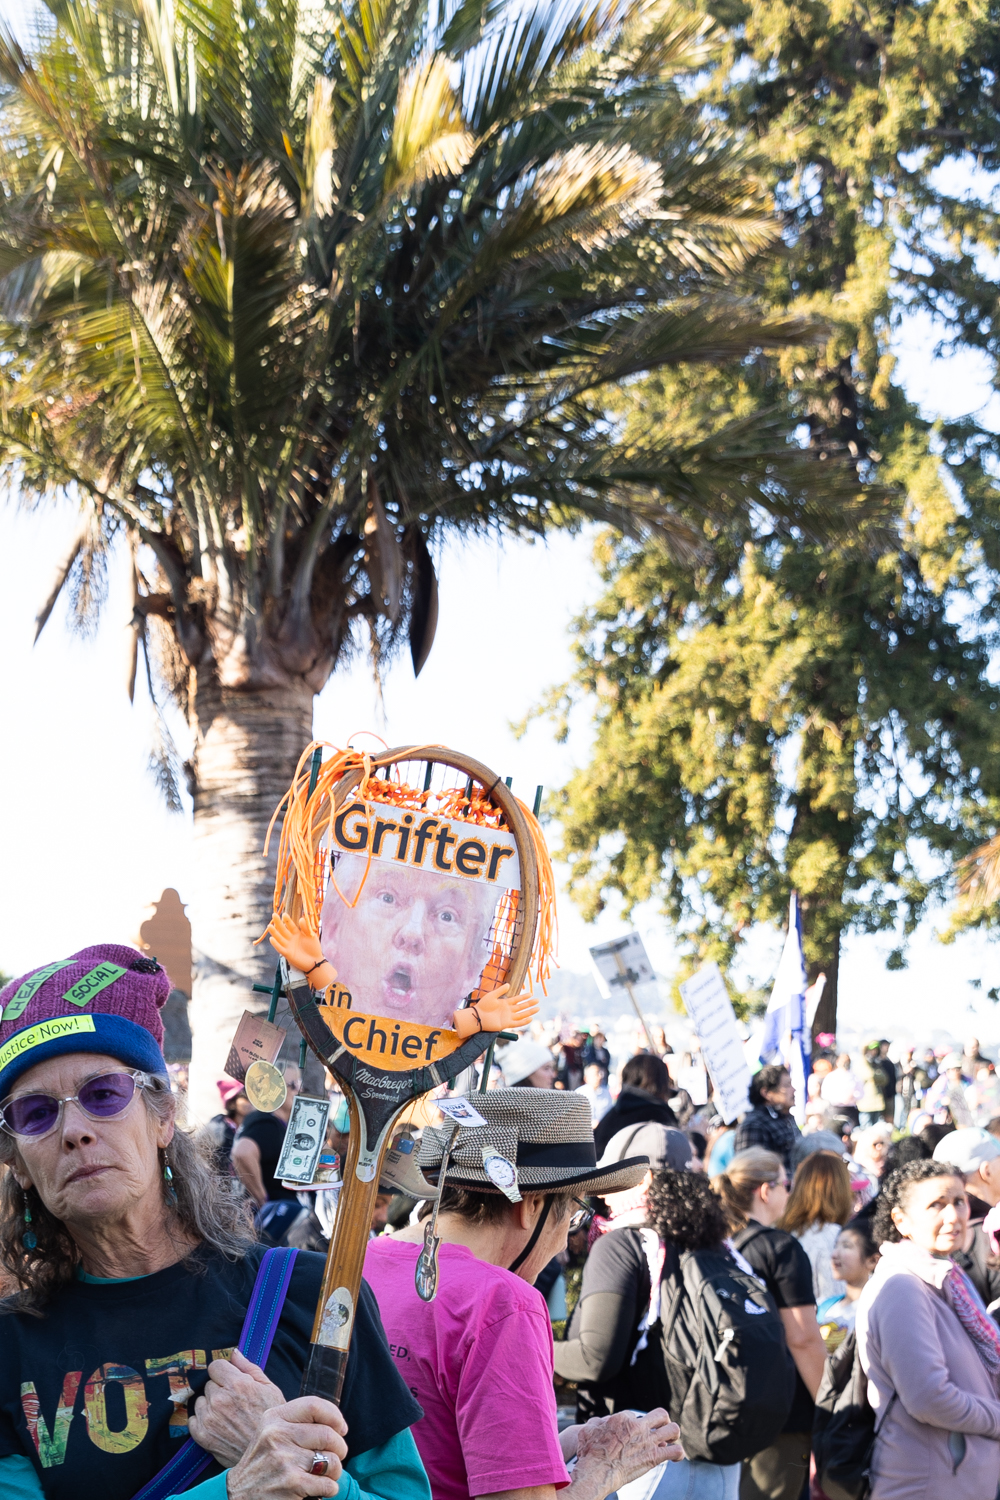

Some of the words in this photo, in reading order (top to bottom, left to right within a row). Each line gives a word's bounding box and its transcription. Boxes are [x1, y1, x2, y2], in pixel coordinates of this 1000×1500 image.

[334, 802, 515, 880] Grifter
[10, 963, 64, 1010] HEALTH
[329, 984, 352, 1009] in
[39, 1018, 80, 1039] Now!
[343, 1017, 442, 1060] Chief
[355, 1068, 414, 1093] MacGregor
[20, 1347, 239, 1468] VOT
